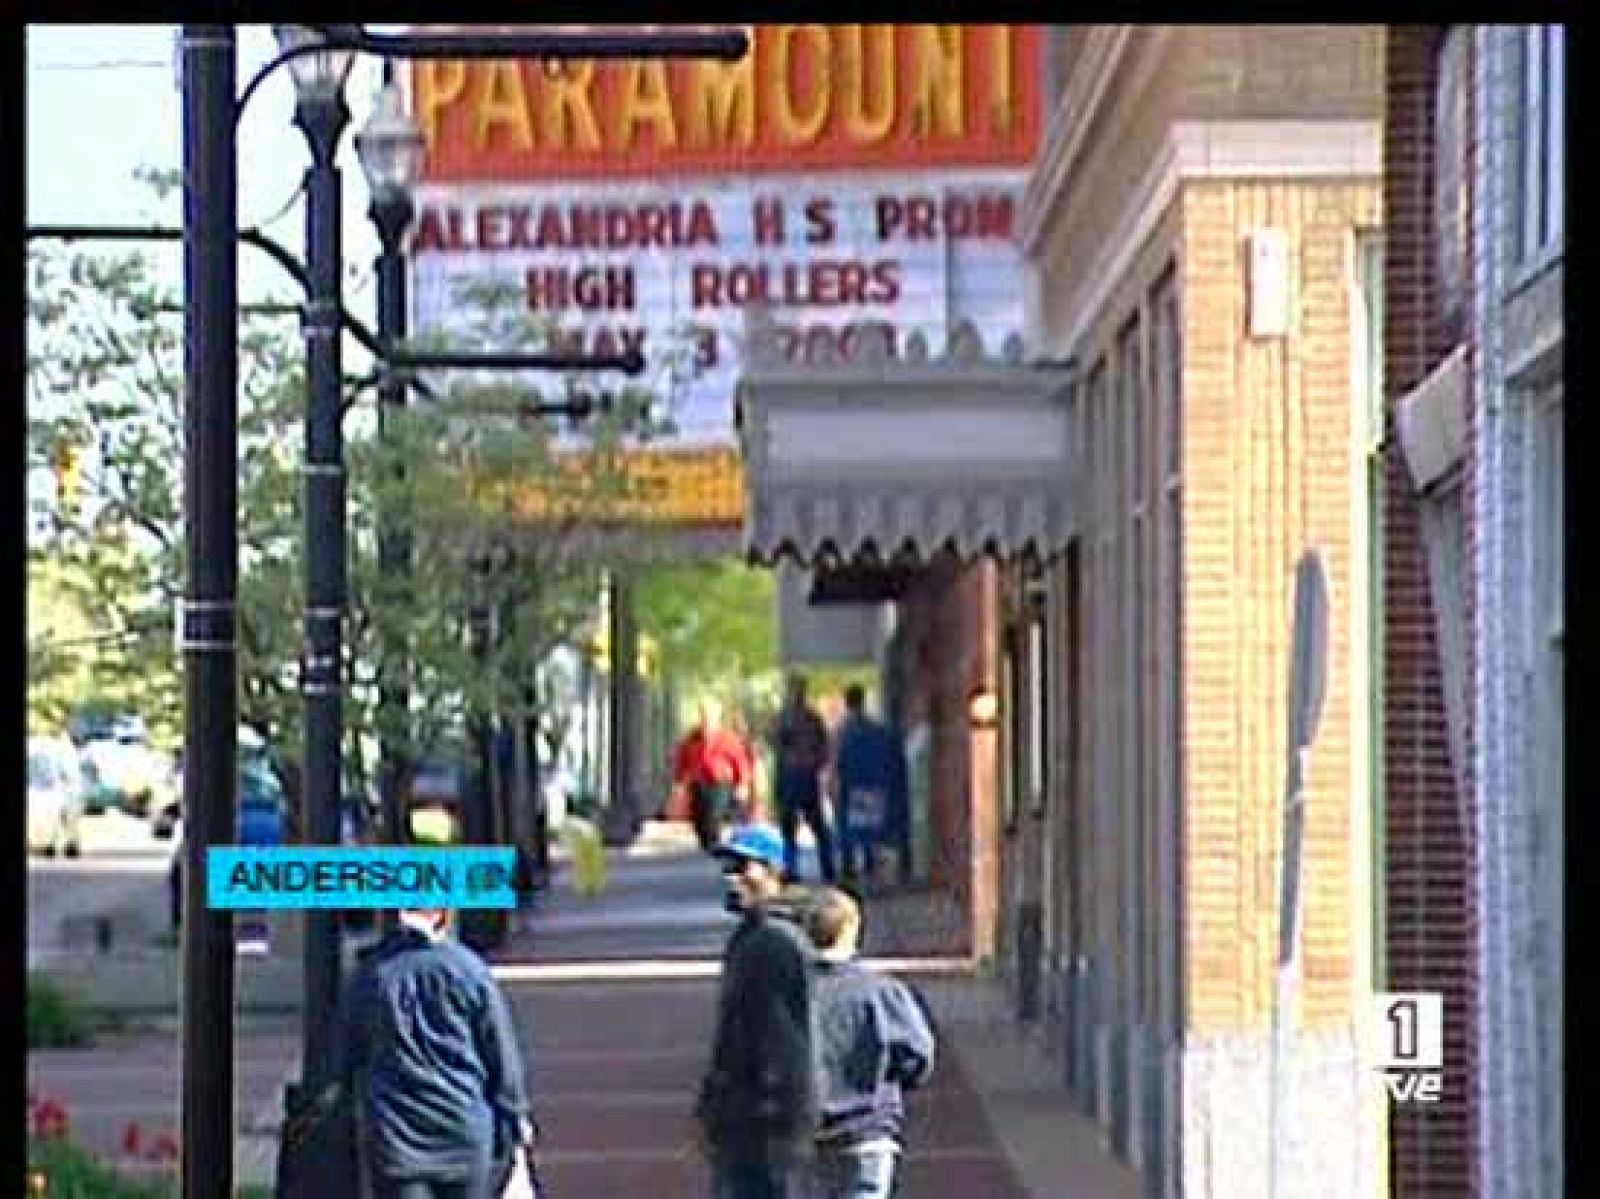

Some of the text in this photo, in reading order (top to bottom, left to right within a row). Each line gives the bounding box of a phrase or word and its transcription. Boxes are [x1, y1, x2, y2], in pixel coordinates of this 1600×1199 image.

[410, 190, 1015, 253] ALEXANDRIA H S PROM
[525, 259, 901, 313] HIGH ROLLERS
